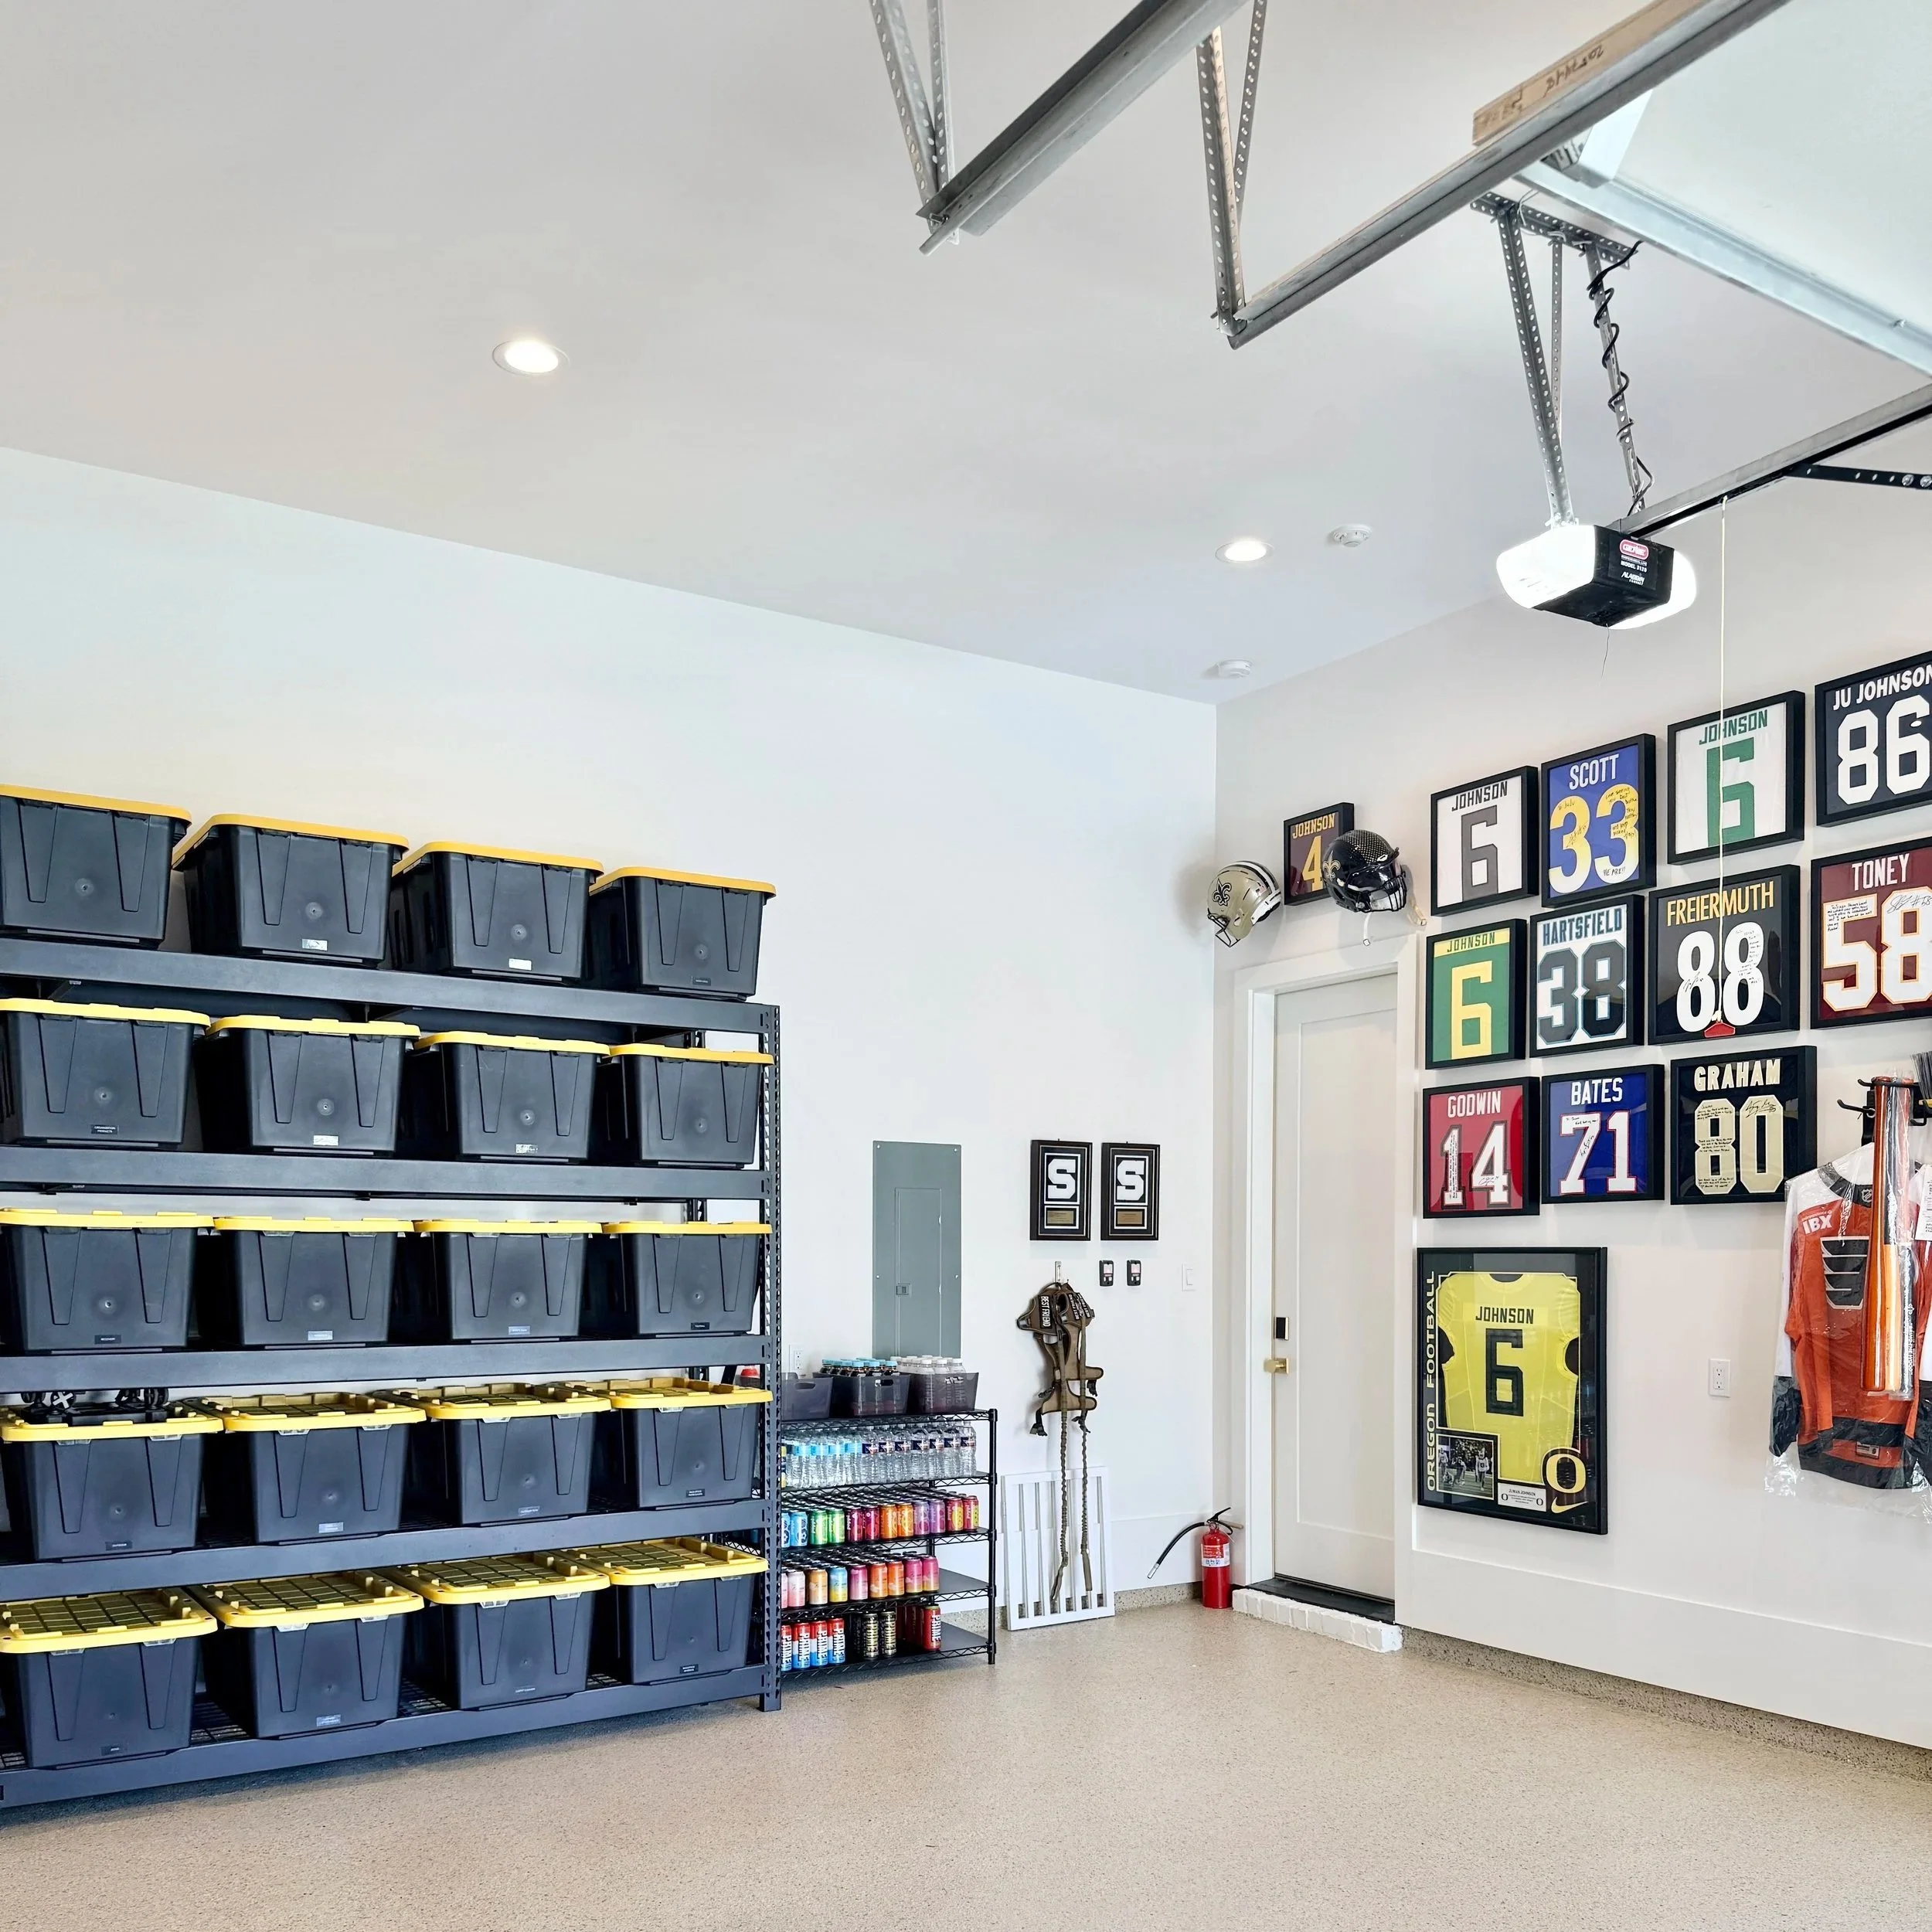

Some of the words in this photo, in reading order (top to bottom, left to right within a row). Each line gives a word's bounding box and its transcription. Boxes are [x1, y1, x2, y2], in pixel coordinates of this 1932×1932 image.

[1833, 688, 1852, 711] JU
[1699, 709, 1768, 746] JOHNSON
[1838, 694, 1930, 805] 86
[1570, 754, 1620, 791] SCOTT
[1706, 736, 1755, 848] 6
[1451, 781, 1508, 811] JOHNSON
[1292, 813, 1335, 839] JOHNSON
[1548, 783, 1639, 894] 33
[1301, 835, 1323, 892] 4
[1461, 804, 1498, 902] 6
[1852, 852, 1910, 891] TONEY
[1666, 881, 1774, 927] FREIERMUTH
[1447, 932, 1495, 954] JOHNSON
[1543, 909, 1623, 946] HARTSFIELD
[1822, 886, 1932, 1012] 58
[1537, 939, 1626, 1046] 38
[1676, 921, 1765, 1032] 88
[1451, 960, 1492, 1060] 6
[1571, 1077, 1623, 1106] BATES
[1694, 1058, 1781, 1092] GRAHAM
[1447, 1090, 1501, 1118] GODWIN
[1559, 1110, 1637, 1196] 71
[1695, 1094, 1784, 1196] 80
[1048, 1159, 1077, 1199] S
[1117, 1160, 1146, 1201] S
[1440, 1120, 1512, 1210] 14
[1802, 1214, 1832, 1234] IBX
[1041, 1296, 1049, 1308] BEST
[1042, 1308, 1051, 1327] FRIEND
[1475, 1306, 1534, 1325] JOHNSON
[1427, 1270, 1436, 1389] FOOTBALL
[1485, 1328, 1524, 1417] 6
[1427, 1402, 1436, 1492] OREGON
[817, 1631, 828, 1659] PRIME
[833, 1628, 845, 1656] PRIME
[932, 1614, 940, 1641] PRIME
[798, 1633, 810, 1662] PRIME
